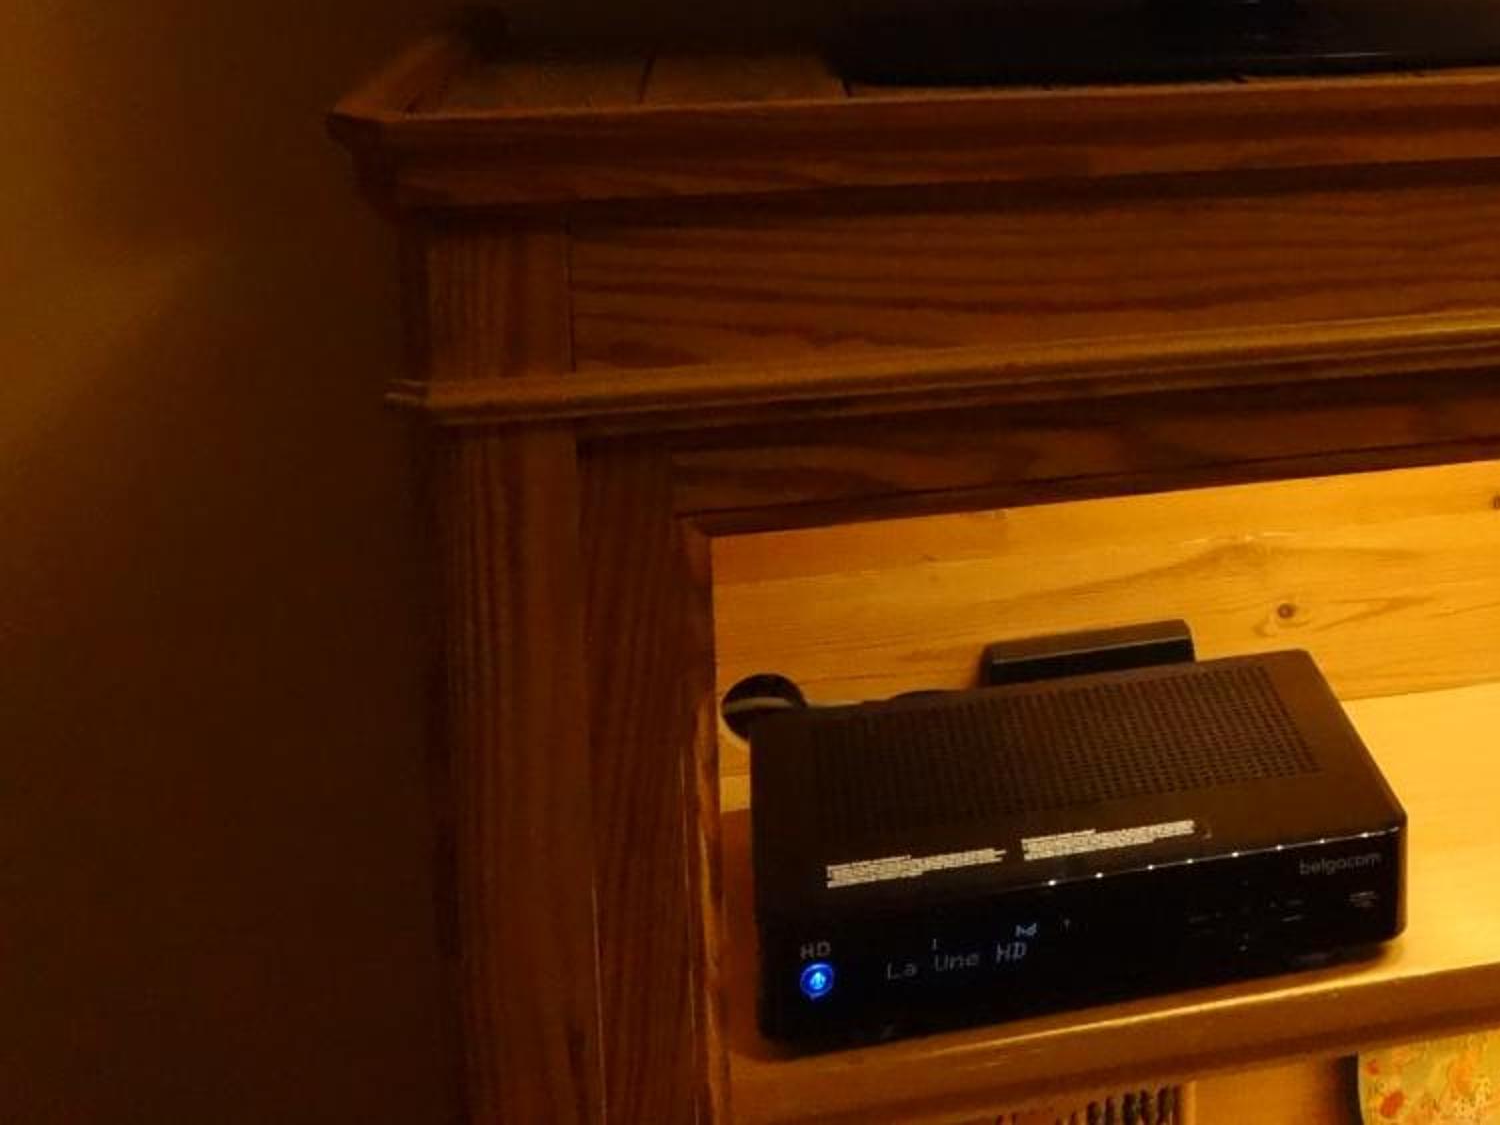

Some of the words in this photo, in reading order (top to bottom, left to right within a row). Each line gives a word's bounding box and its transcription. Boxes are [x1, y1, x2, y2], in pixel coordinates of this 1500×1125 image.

[800, 941, 832, 959] HD
[887, 962, 918, 981] La
[932, 952, 980, 972] Une
[995, 941, 1028, 964] HD
